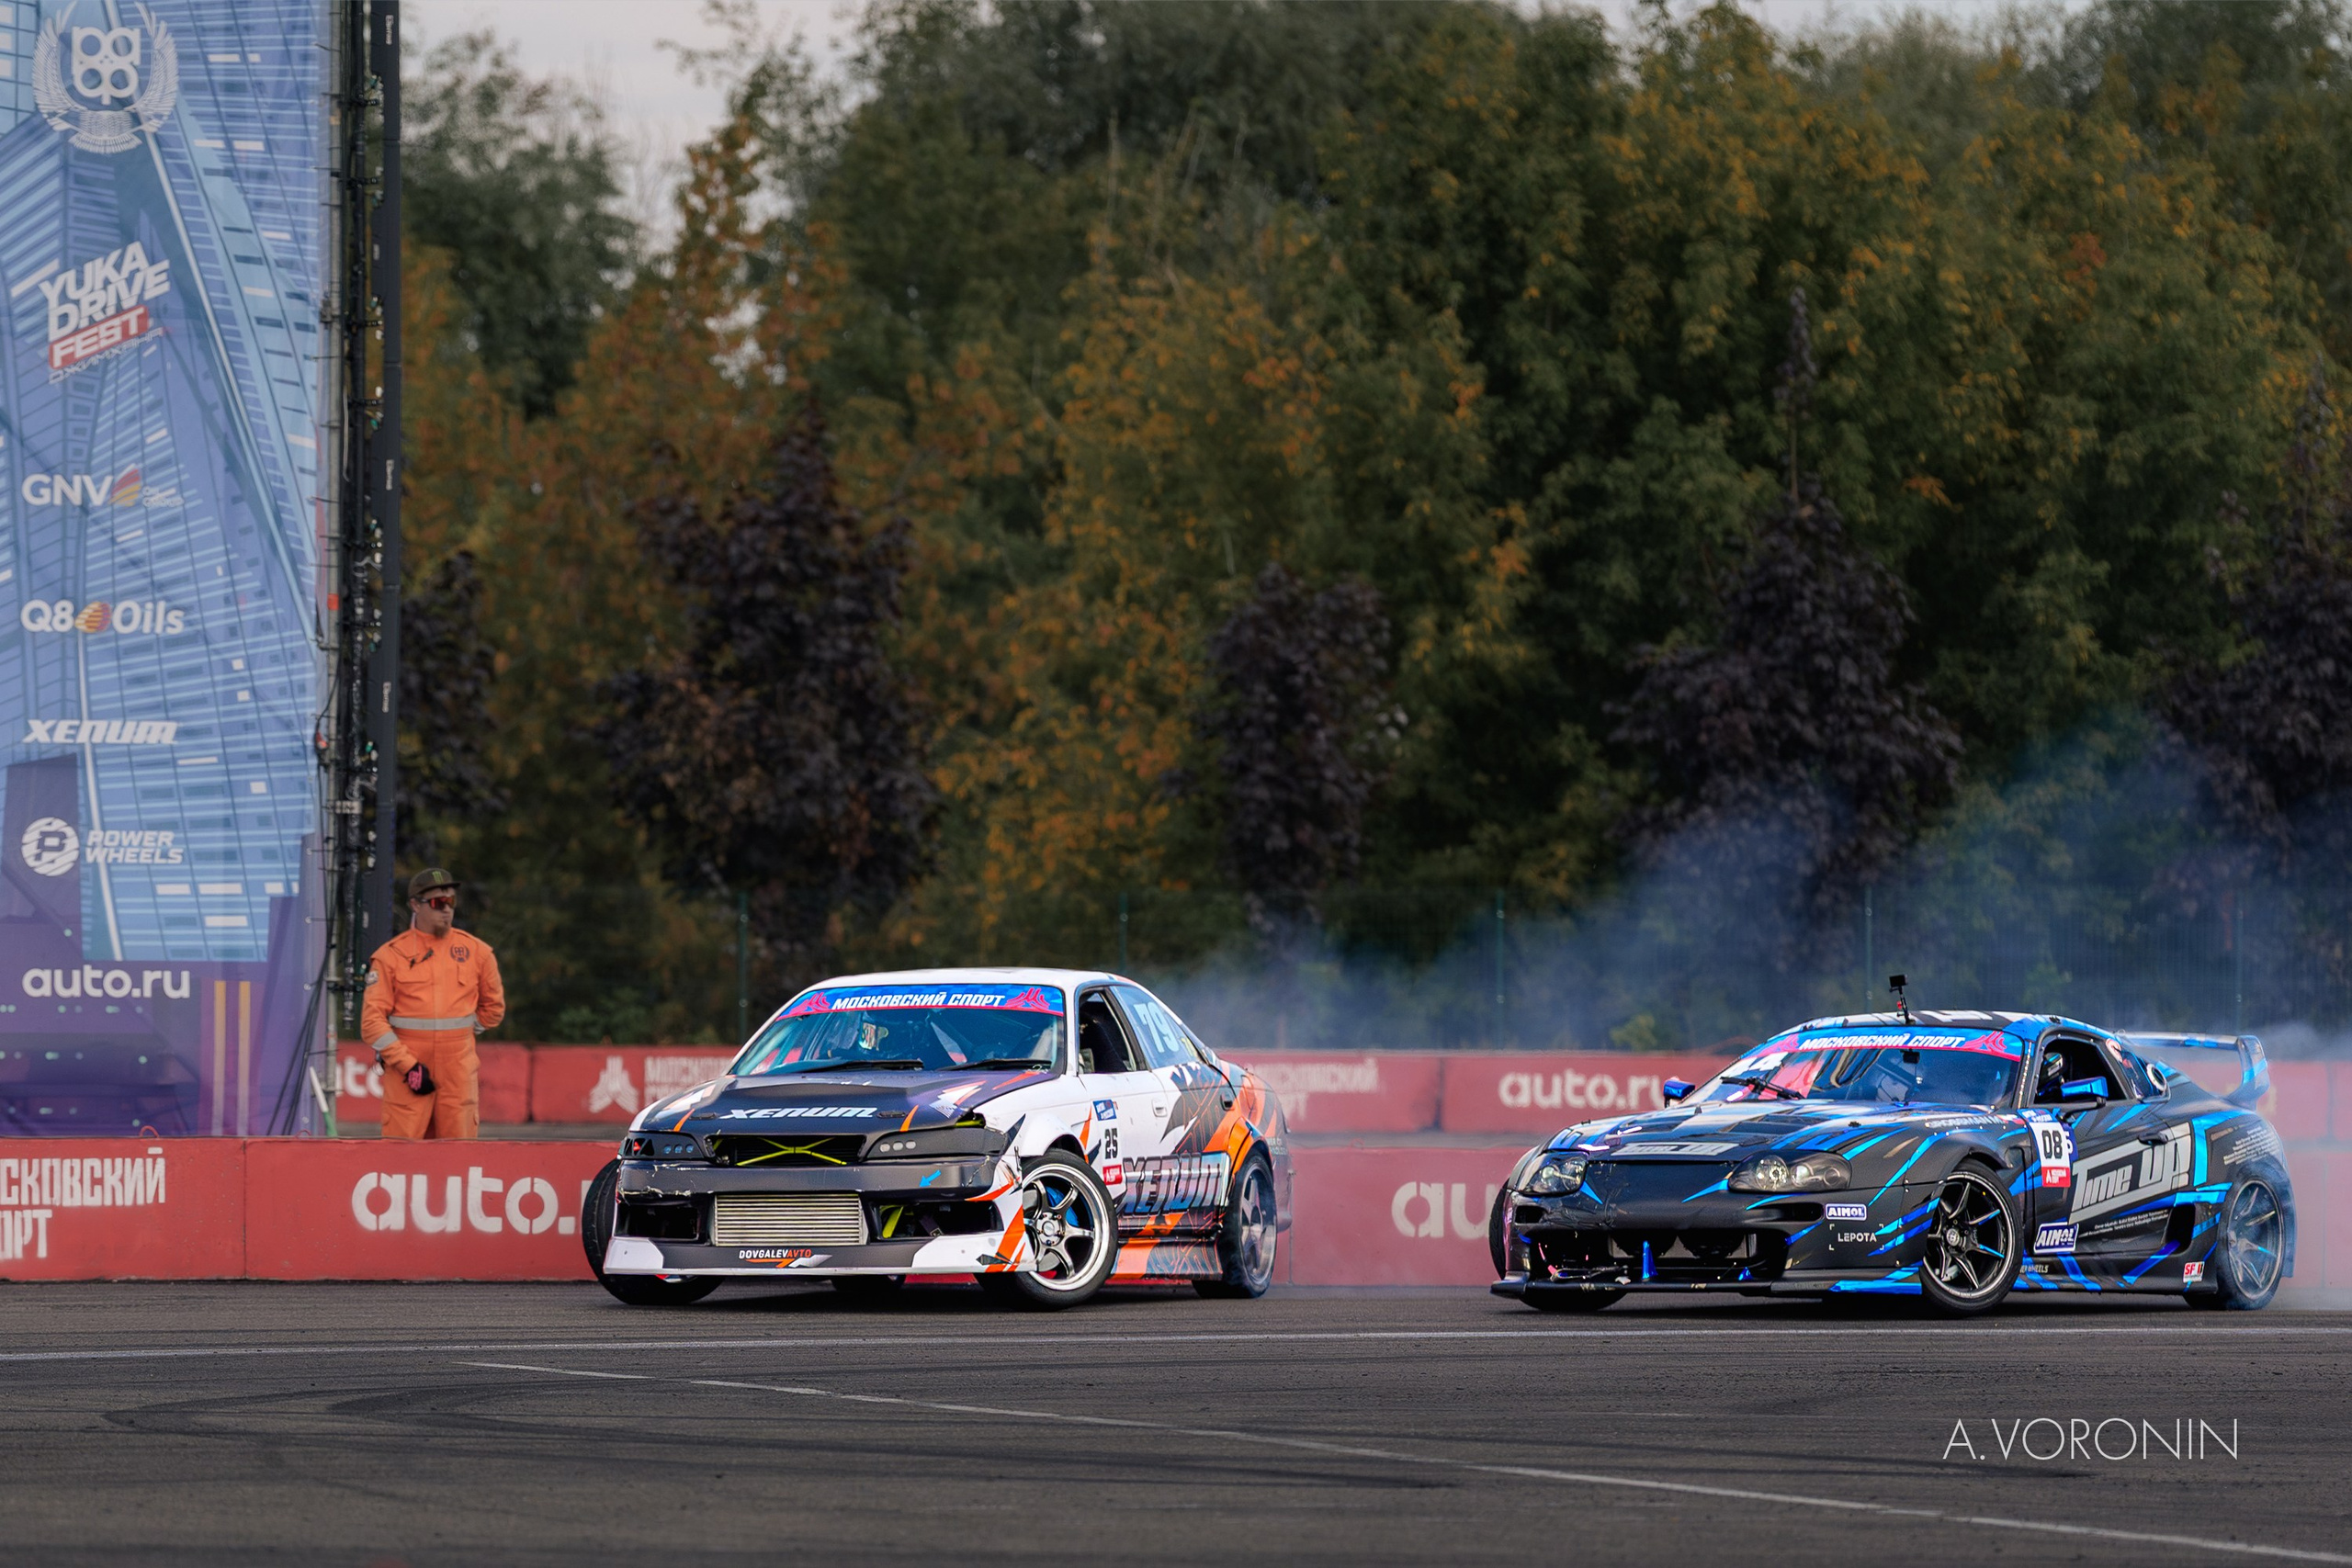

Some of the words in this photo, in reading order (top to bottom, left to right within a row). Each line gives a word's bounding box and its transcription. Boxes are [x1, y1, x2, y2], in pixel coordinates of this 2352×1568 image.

[38, 241, 150, 310] YUKA
[48, 259, 170, 342] DRIVE
[52, 307, 145, 367] FEST
[21, 474, 113, 505] GNV
[86, 830, 175, 847] POWER
[85, 847, 183, 864] WHEELS
[22, 964, 190, 999] auto.ru
[831, 992, 946, 1010] МОСКОВСКИЙ
[946, 995, 1005, 1008] СПОРТ
[1133, 1001, 1180, 1054] 79
[1799, 1033, 1910, 1050] МОСКОВСКИЙ
[1907, 1035, 1965, 1049] СПОРТ
[1104, 1128, 1118, 1159] 25
[2042, 1130, 2063, 1159] 08
[352, 1167, 589, 1235] auto.
[1827, 1207, 1865, 1217] AIMOL
[1838, 1233, 1877, 1242] LEPOTA
[2036, 1227, 2075, 1247] AIMOL
